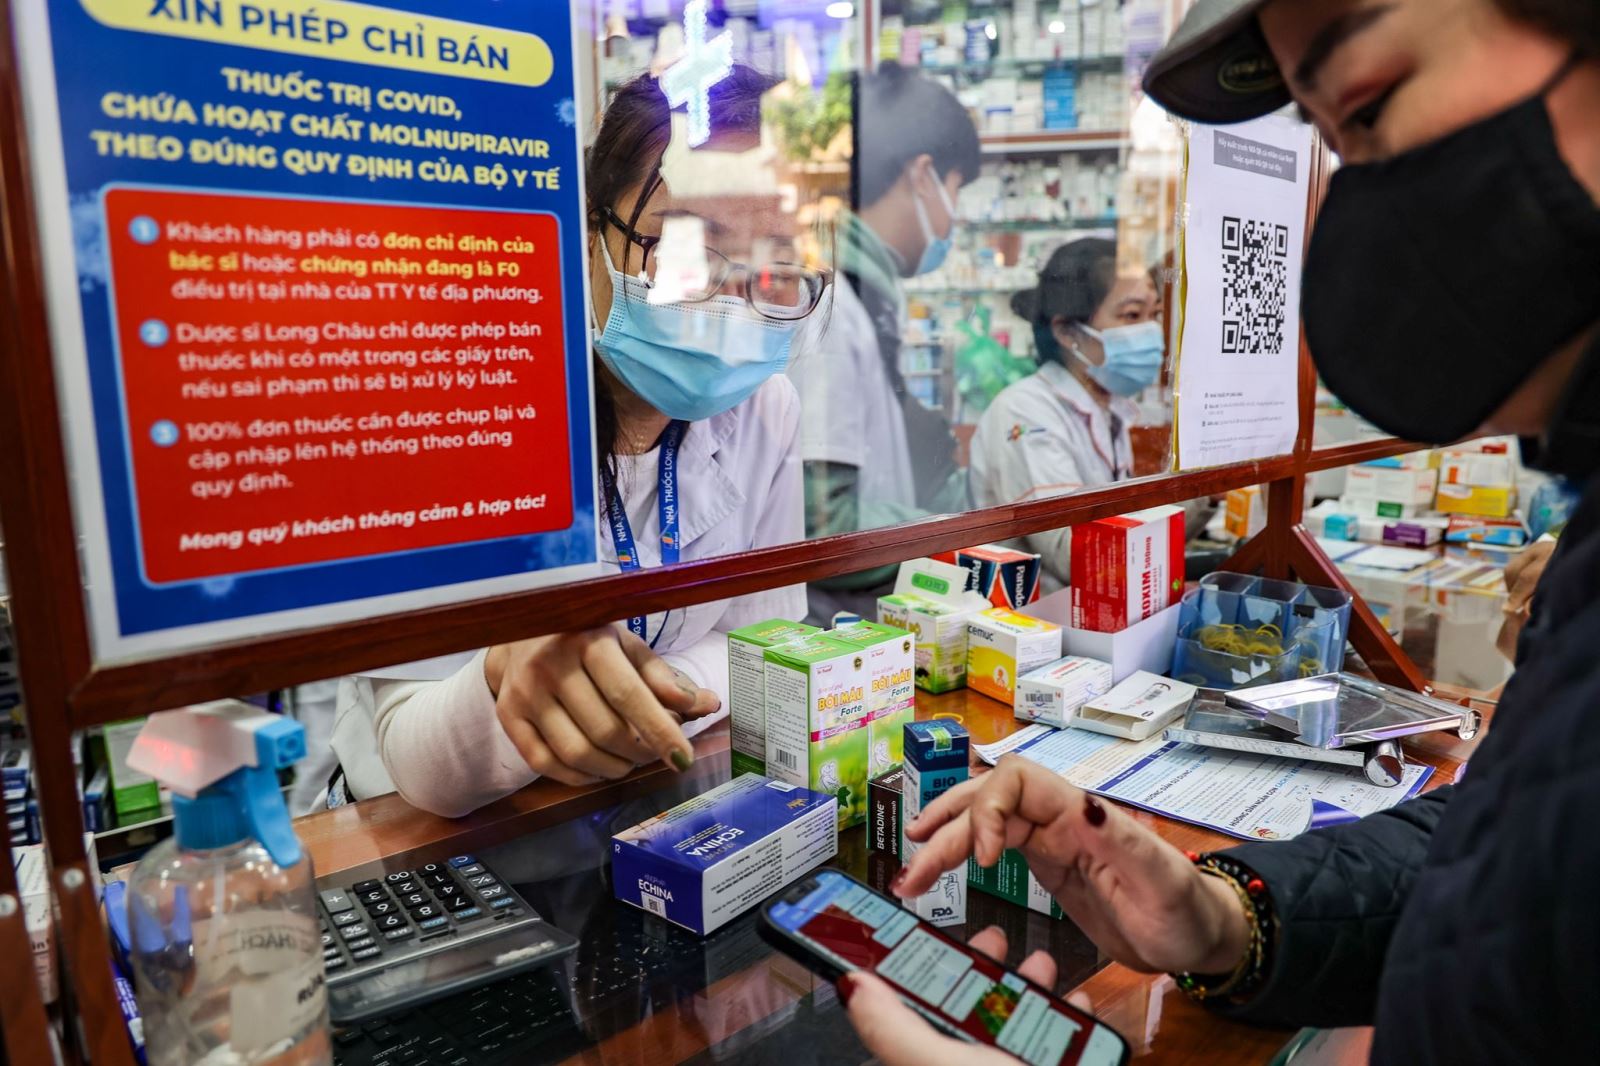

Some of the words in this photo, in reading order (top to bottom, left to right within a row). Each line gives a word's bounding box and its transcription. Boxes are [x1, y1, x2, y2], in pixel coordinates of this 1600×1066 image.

[149, 0, 222, 26] XIN
[240, 5, 348, 45] PHÉP
[363, 23, 424, 58] CHỈ
[438, 36, 509, 71] BÁN
[221, 67, 323, 101] THUỐC
[328, 82, 371, 112] TRỊ
[377, 89, 462, 121] COVID,
[101, 92, 198, 125] CHỨA
[203, 103, 285, 137] HOẠT
[291, 113, 364, 141] CHẤT
[370, 122, 550, 158] MOLNUPIRAVIR
[89, 130, 183, 161] THEO
[189, 137, 278, 169] ĐÚNG
[283, 148, 342, 176] QUY
[347, 154, 413, 182] ĐỊNH
[418, 156, 470, 184] CỦA
[474, 163, 508, 190] BỘ
[512, 169, 528, 188] Y
[532, 166, 560, 190] TẾ
[166, 221, 240, 243] Khách
[245, 224, 302, 249] hàng
[307, 228, 351, 248] phải
[355, 230, 380, 248] có
[384, 232, 421, 250] đơn
[458, 235, 499, 254] định
[502, 236, 535, 253] của
[169, 250, 214, 271] bác
[242, 252, 297, 276] hoặc
[300, 255, 367, 278] chứng
[372, 257, 422, 278] nhận
[426, 259, 473, 279] đang
[477, 260, 493, 276] là
[171, 277, 224, 299] điều
[228, 280, 254, 302] trị
[257, 280, 286, 302] tại
[291, 281, 331, 299] nhà
[335, 281, 372, 299] của
[375, 283, 398, 299] TT
[401, 283, 415, 299] Y
[418, 282, 438, 300] tế
[441, 283, 468, 303] địa
[472, 284, 544, 304] phương.
[175, 322, 238, 346] Dược
[265, 323, 319, 344] Long
[322, 321, 375, 340] Châu
[412, 321, 457, 341] được
[461, 321, 505, 340] phép
[509, 321, 541, 337] bán
[178, 350, 245, 371] thuốc
[250, 349, 285, 368] khi
[289, 351, 315, 368] có
[319, 348, 360, 368] một
[364, 350, 417, 367] trong
[421, 347, 452, 363] các
[455, 345, 491, 365] giấy
[494, 345, 534, 362] trên,
[182, 378, 227, 398] nếu
[231, 376, 262, 396] sai
[267, 376, 329, 398] phạm
[390, 372, 408, 392] bị
[412, 370, 435, 388] xử
[438, 370, 453, 390] lý
[480, 368, 518, 387] luật.
[185, 421, 243, 442] 100%
[247, 419, 290, 438] đơn
[294, 414, 354, 435] thuốc
[396, 410, 443, 429] được
[446, 407, 491, 425] chụp
[494, 404, 513, 423] lại
[516, 404, 536, 420] và
[188, 447, 230, 471] cập
[295, 442, 327, 460] lên
[331, 438, 357, 459] hệ
[361, 435, 419, 456] thống
[422, 433, 464, 450] theo
[467, 429, 512, 447] đúng
[664, 448, 675, 470] LONG
[191, 479, 234, 499] quy
[238, 470, 294, 494] định.
[662, 471, 674, 503] THUỐC
[179, 530, 244, 552] Mong
[248, 521, 289, 546] quý
[291, 514, 356, 538] khách
[359, 510, 415, 529] thông
[418, 503, 459, 522] cảm
[462, 502, 474, 517] &
[478, 499, 511, 517] hợp
[514, 493, 546, 510] tác!
[664, 505, 675, 525] NHÀ
[972, 560, 982, 590] Pana
[1016, 565, 1025, 608] Panado
[968, 625, 994, 642] cemuc
[892, 686, 910, 697] Forte
[840, 705, 863, 716] Forte
[933, 776, 956, 788] BIO
[877, 803, 885, 850] BETADINE
[686, 827, 744, 857] ECHINA
[388, 871, 409, 881] 00
[401, 882, 414, 891] 2
[368, 891, 380, 900] 3
[410, 894, 422, 903] 5
[442, 885, 453, 894] 4
[454, 897, 465, 906] 7
[480, 886, 501, 897] AC
[638, 879, 673, 903] ECHINA
[419, 907, 432, 916] 8
[932, 906, 953, 917] FDA
